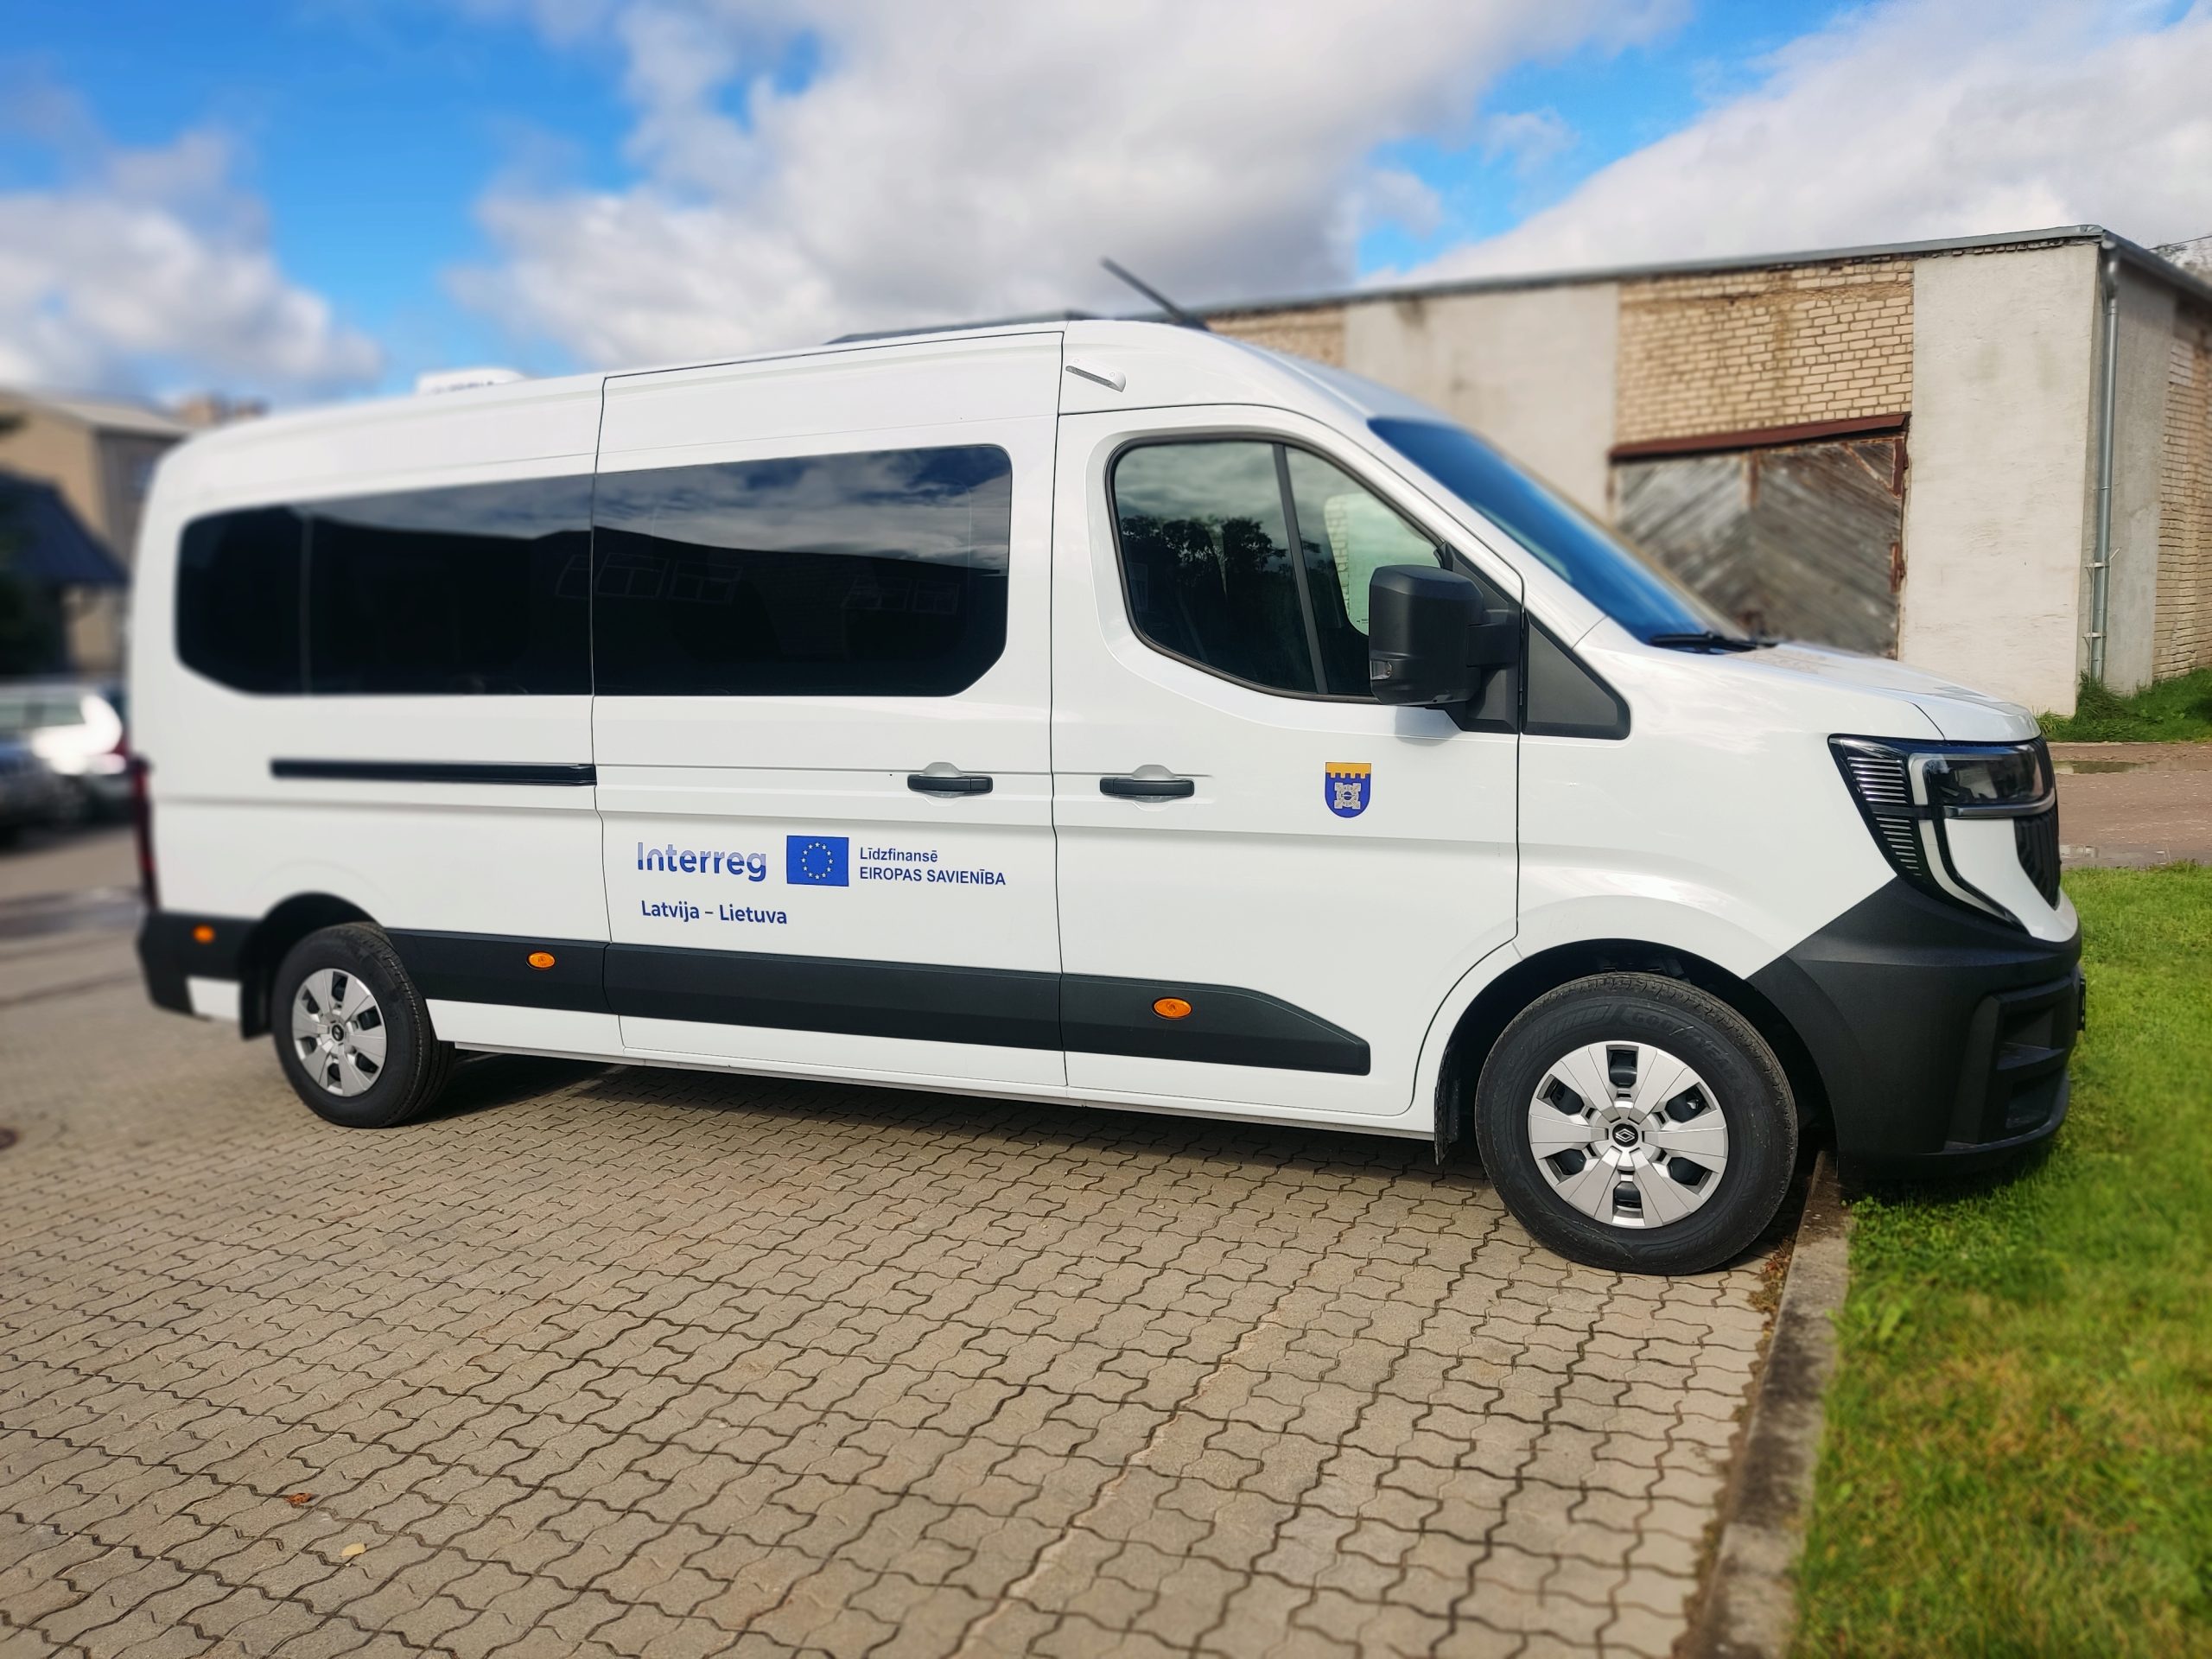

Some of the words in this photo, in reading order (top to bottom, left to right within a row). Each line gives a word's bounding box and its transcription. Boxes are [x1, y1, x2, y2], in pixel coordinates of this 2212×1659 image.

[638, 842, 766, 882] Interreg
[860, 847, 938, 862] Līdzfinansē
[860, 867, 922, 882] EIROPAS
[926, 869, 1007, 886] SAVIENĪBA
[641, 899, 700, 923] Latvija
[719, 904, 787, 925] Lietuva
